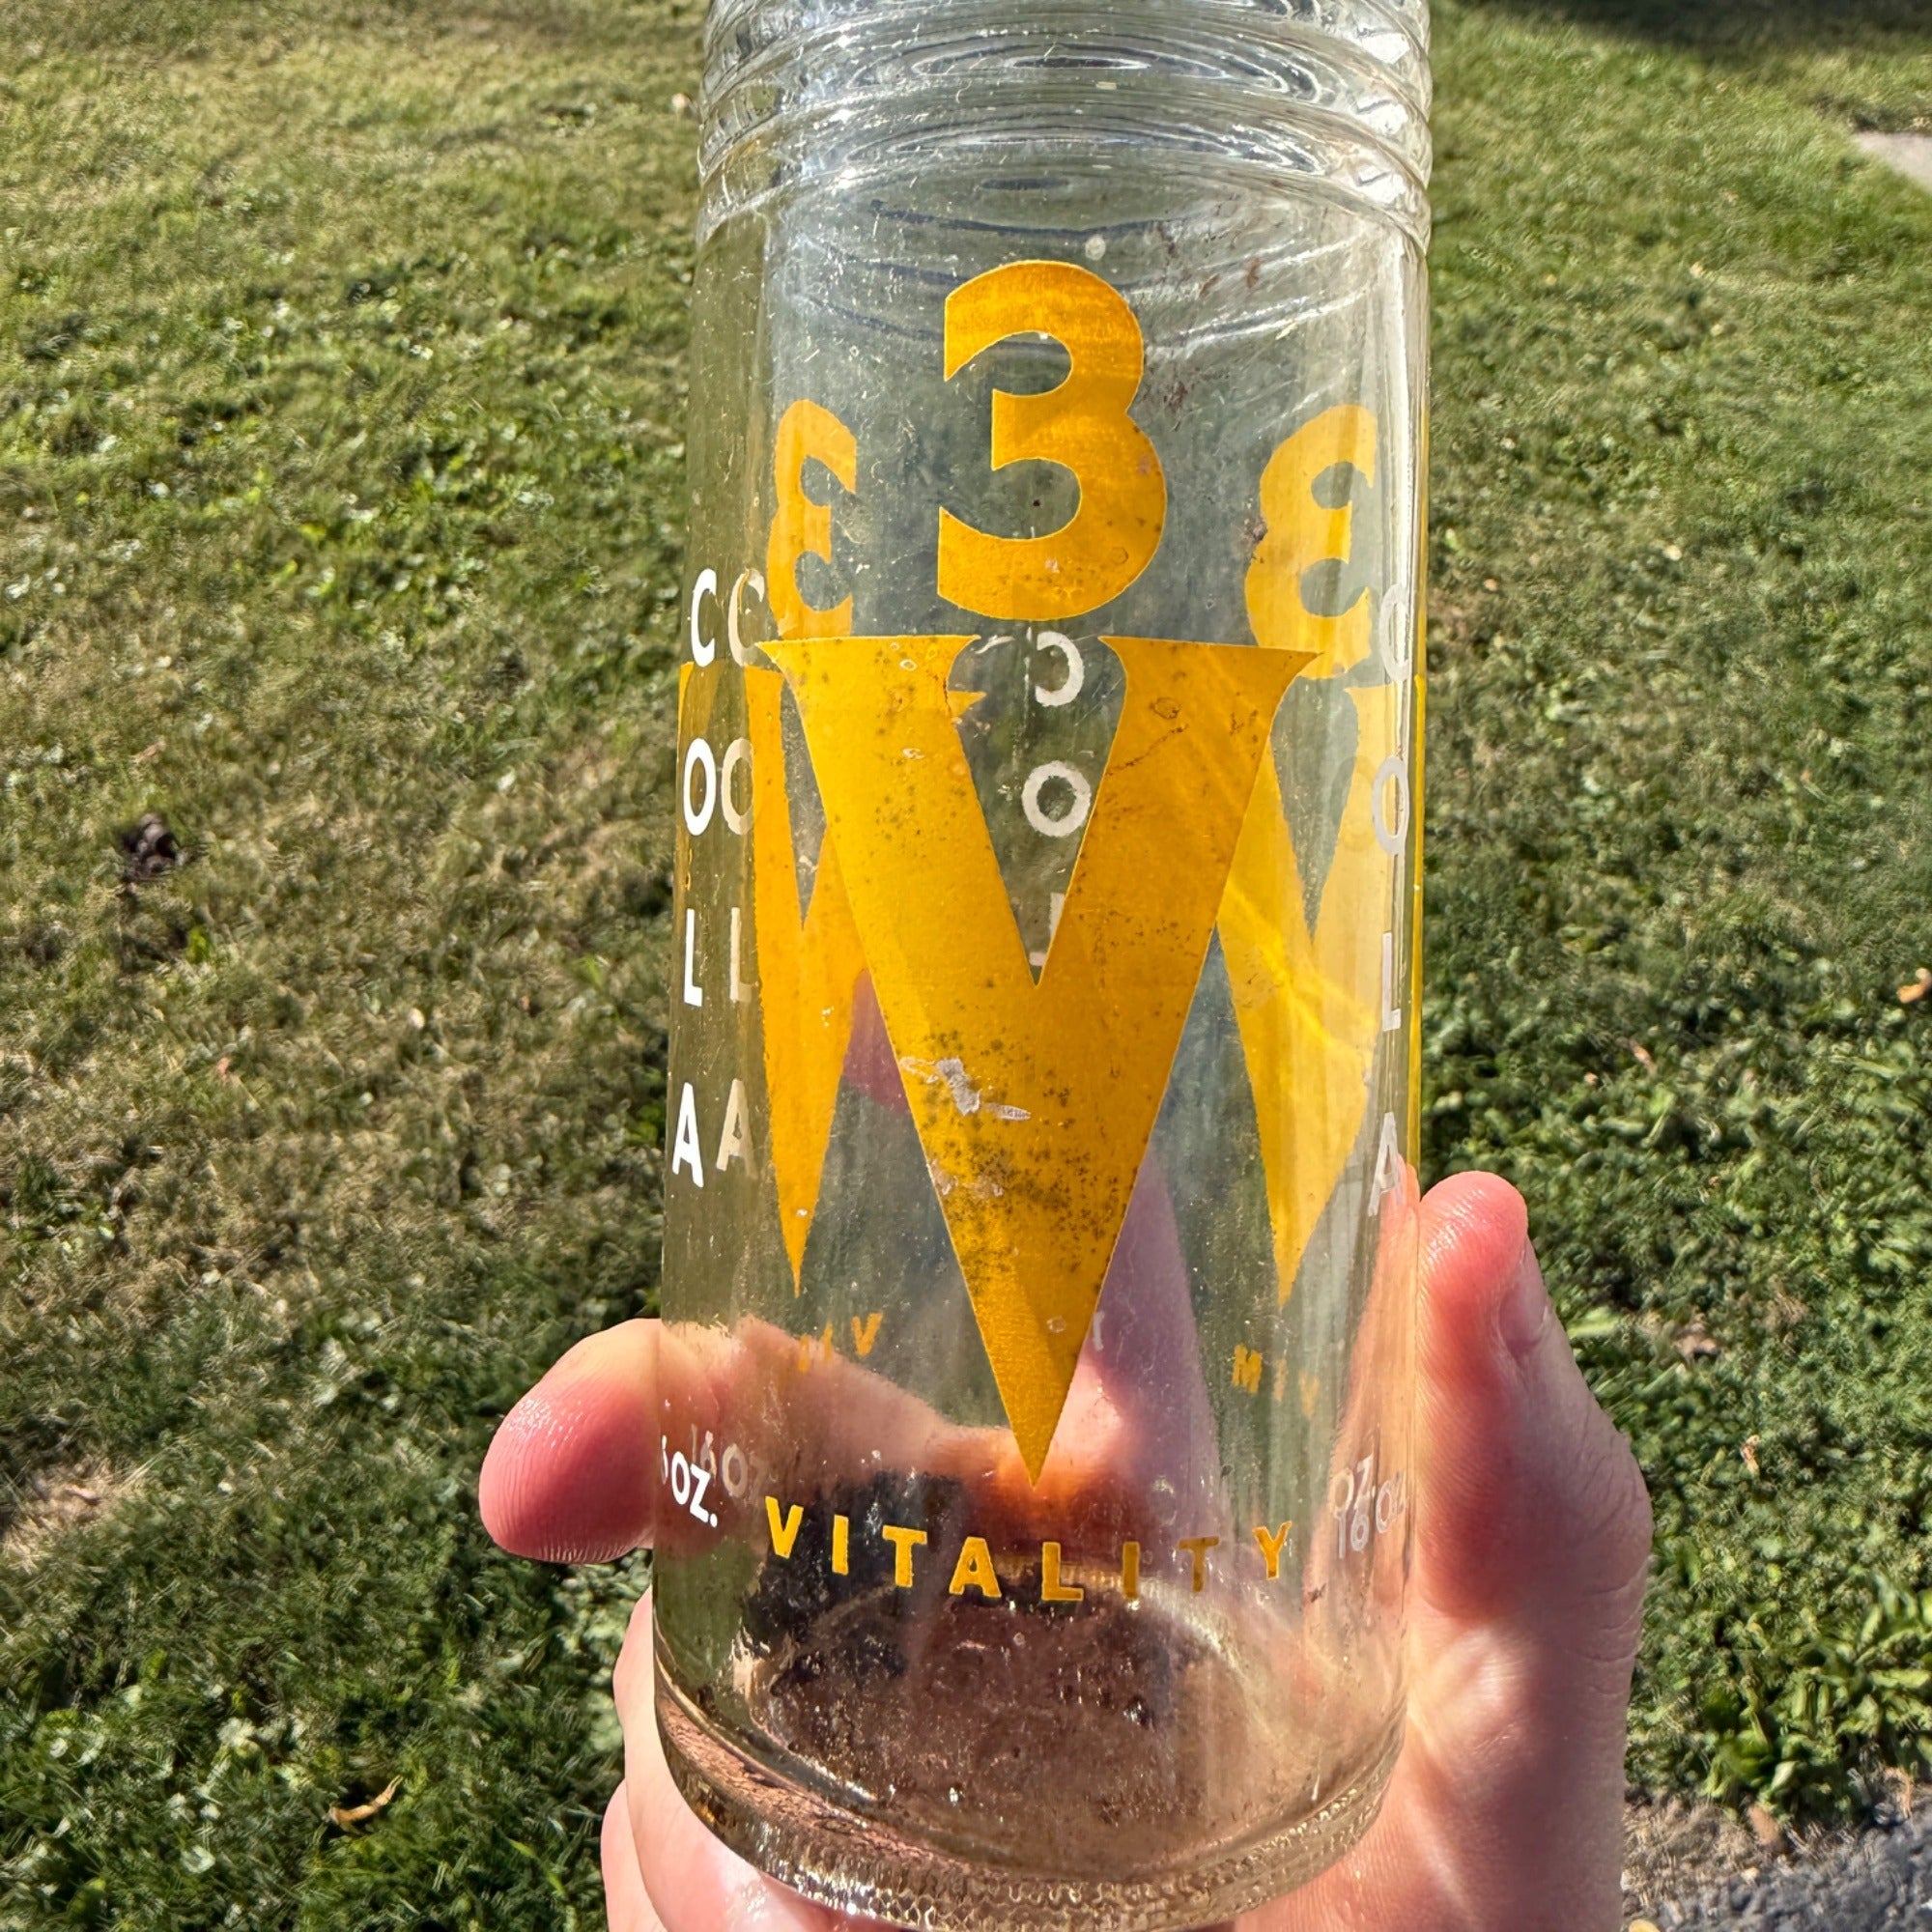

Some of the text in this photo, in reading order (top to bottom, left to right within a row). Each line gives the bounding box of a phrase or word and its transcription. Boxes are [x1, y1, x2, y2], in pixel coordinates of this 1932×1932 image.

[936, 259, 1167, 621] 3
[670, 567, 718, 1188] COLA
[755, 634, 1324, 1489] V
[764, 1494, 1293, 1603] VITALITY
